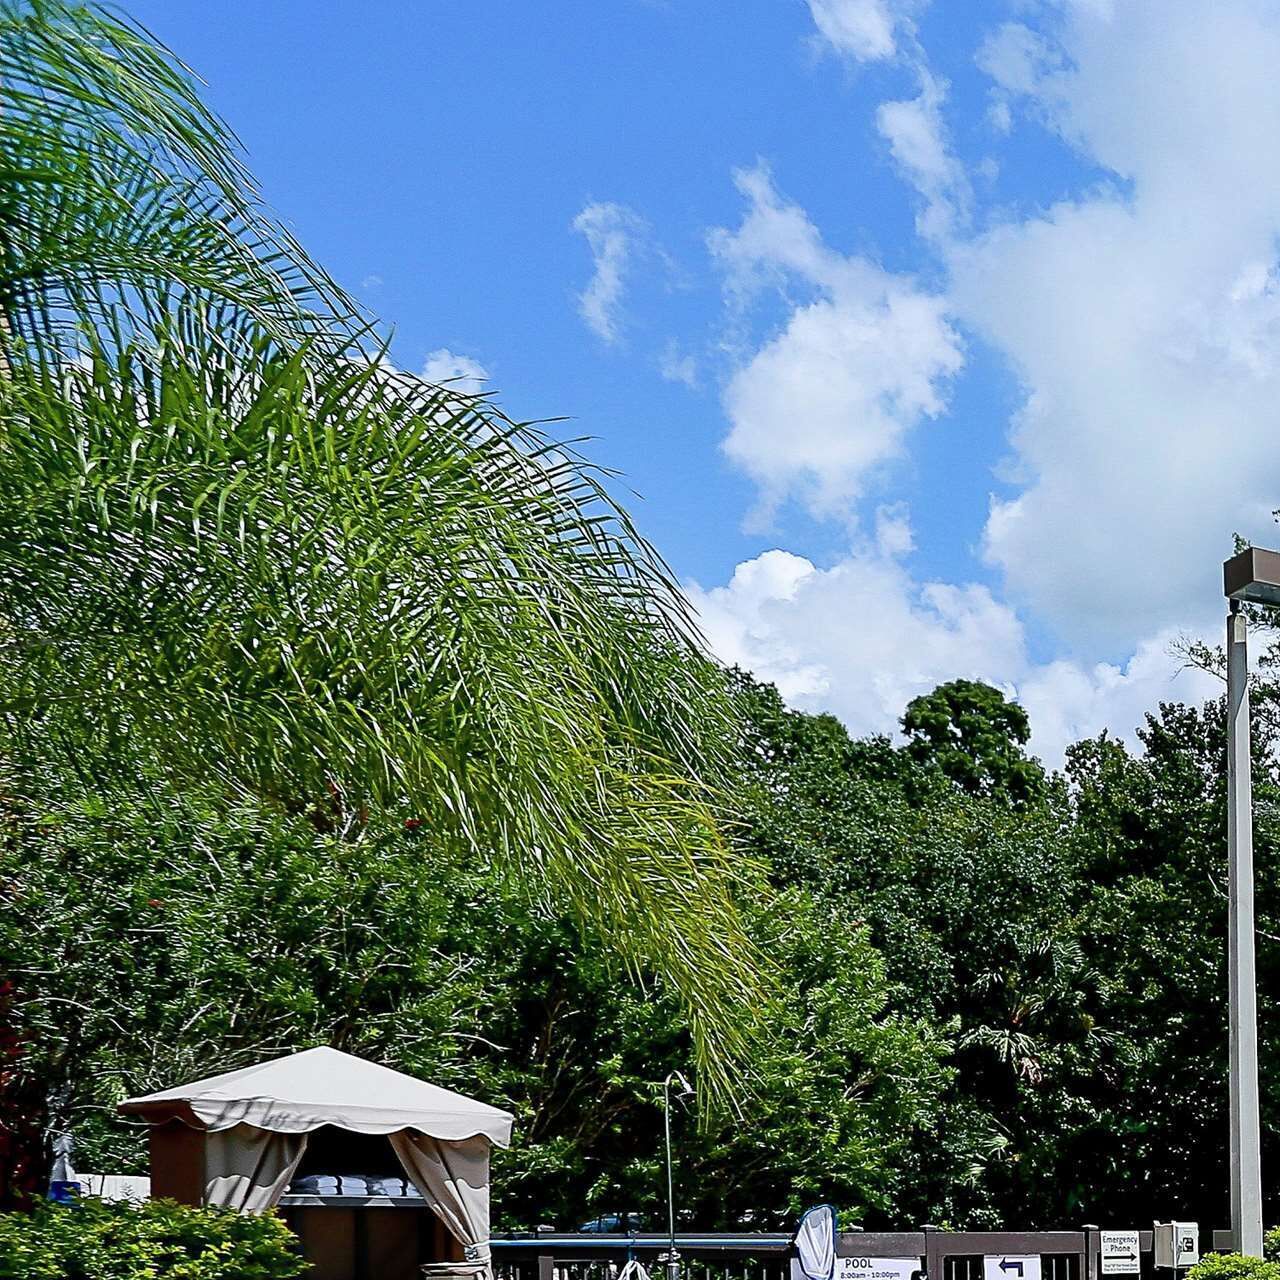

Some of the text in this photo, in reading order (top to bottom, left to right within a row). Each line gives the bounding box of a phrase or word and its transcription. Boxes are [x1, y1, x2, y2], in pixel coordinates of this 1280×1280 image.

[1102, 1235, 1137, 1245] Emergency
[1110, 1244, 1131, 1252] Phone
[845, 1258, 873, 1268] POOL
[872, 1271, 900, 1279] 10:00pm
